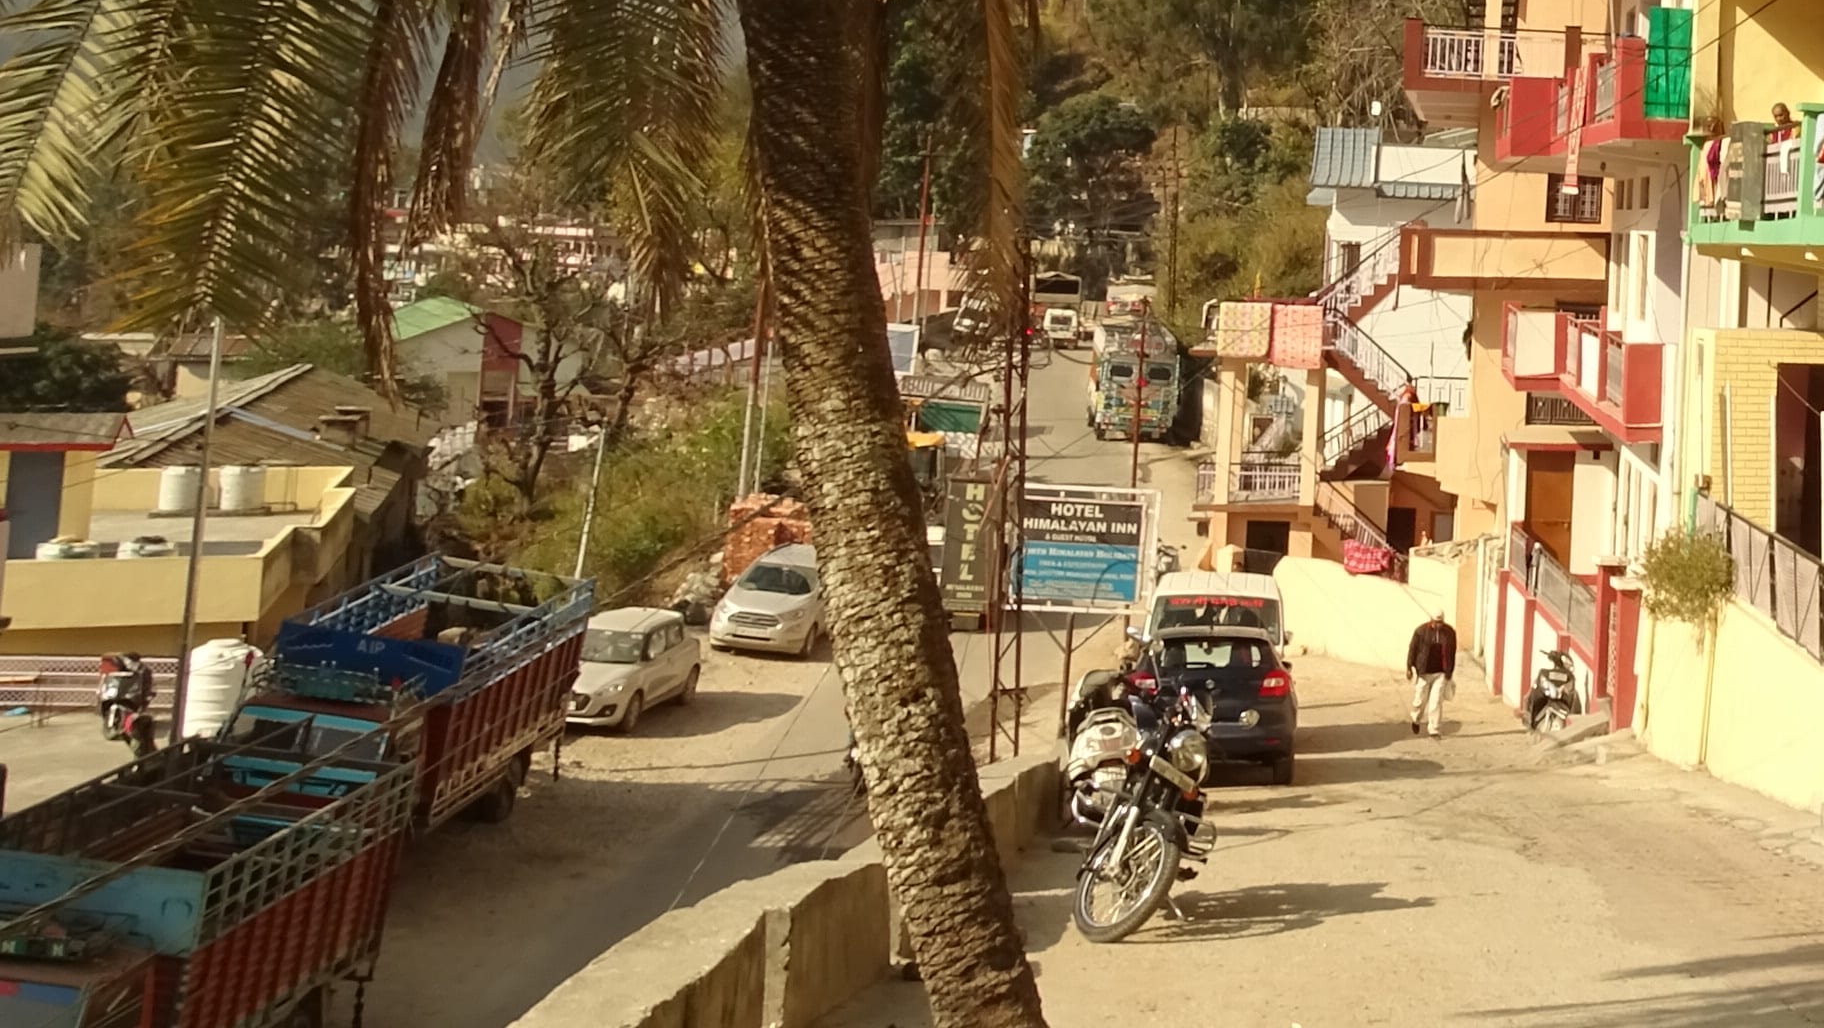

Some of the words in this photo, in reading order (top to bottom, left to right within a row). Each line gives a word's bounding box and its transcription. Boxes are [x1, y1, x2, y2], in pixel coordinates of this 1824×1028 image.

[1050, 503, 1104, 518] HOTEL
[960, 483, 985, 580] HOTEL
[1023, 517, 1107, 533] HIMALAYAN
[1111, 522, 1138, 534] INN
